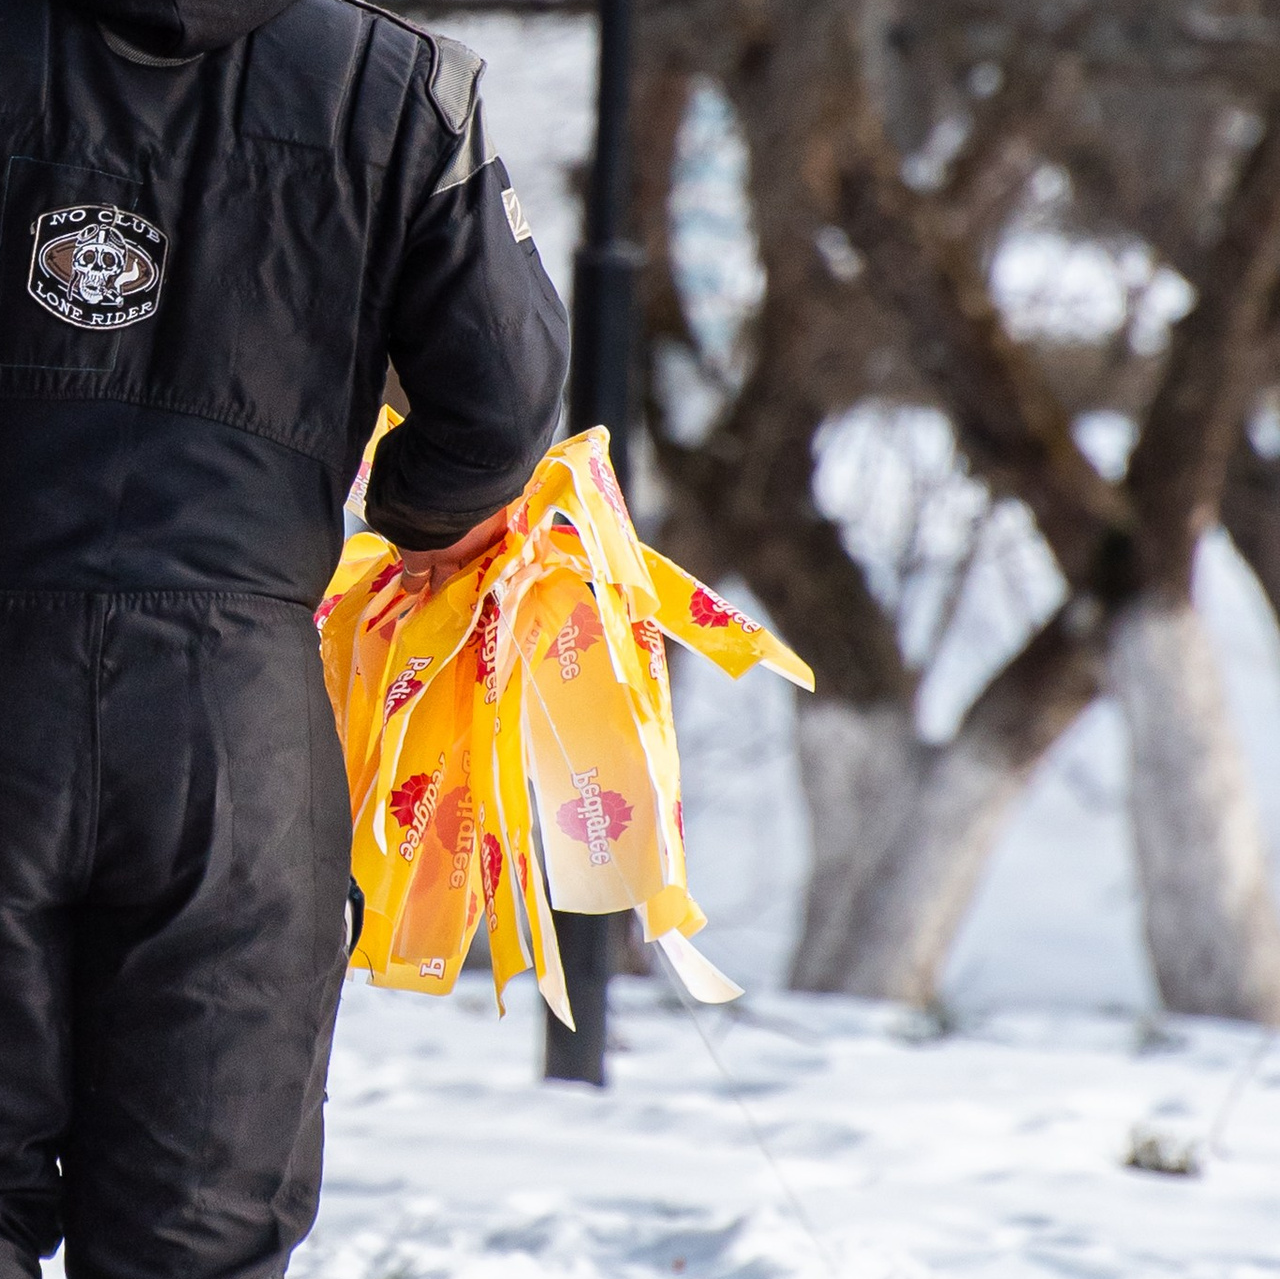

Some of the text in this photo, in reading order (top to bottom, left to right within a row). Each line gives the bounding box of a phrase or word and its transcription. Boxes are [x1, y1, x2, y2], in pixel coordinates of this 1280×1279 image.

[49, 209, 161, 244] NO CLUB
[36, 281, 154, 325] LONE RIDER
